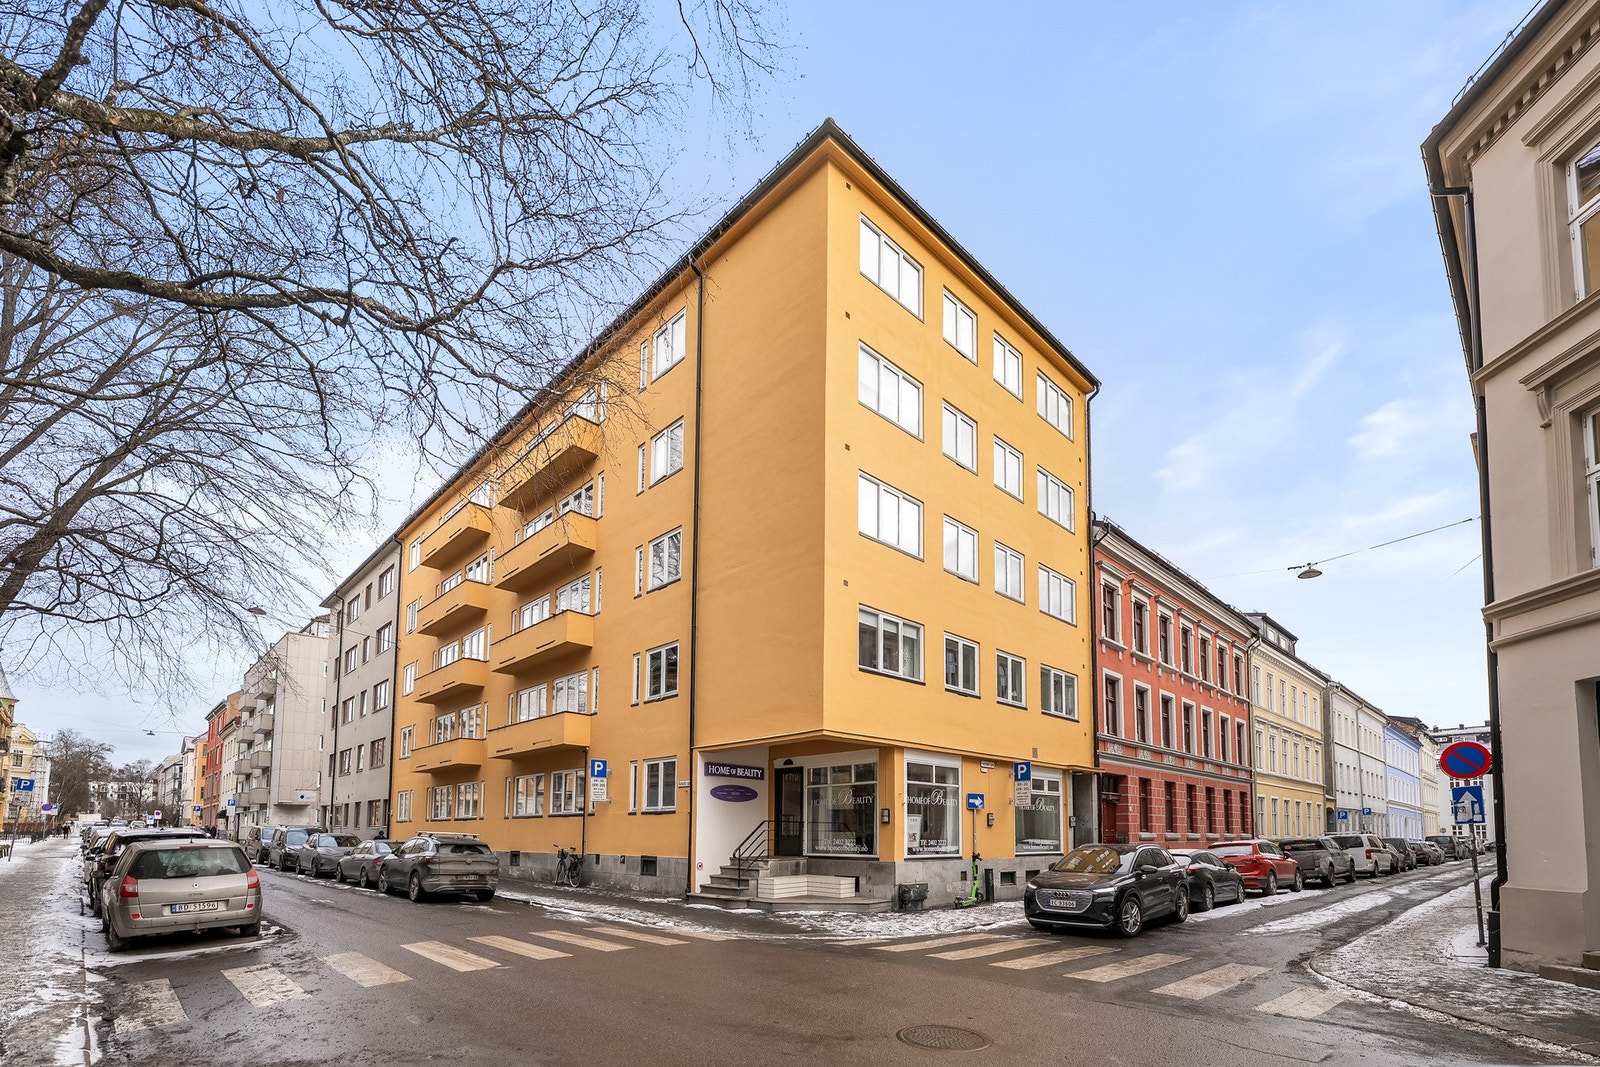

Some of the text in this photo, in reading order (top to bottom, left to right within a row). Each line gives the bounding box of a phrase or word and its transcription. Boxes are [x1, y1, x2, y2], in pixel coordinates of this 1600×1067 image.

[595, 762, 604, 775] P
[708, 765, 730, 775] HOME
[737, 767, 762, 778] BEAUTY
[1018, 764, 1027, 779] P
[20, 780, 30, 789] P
